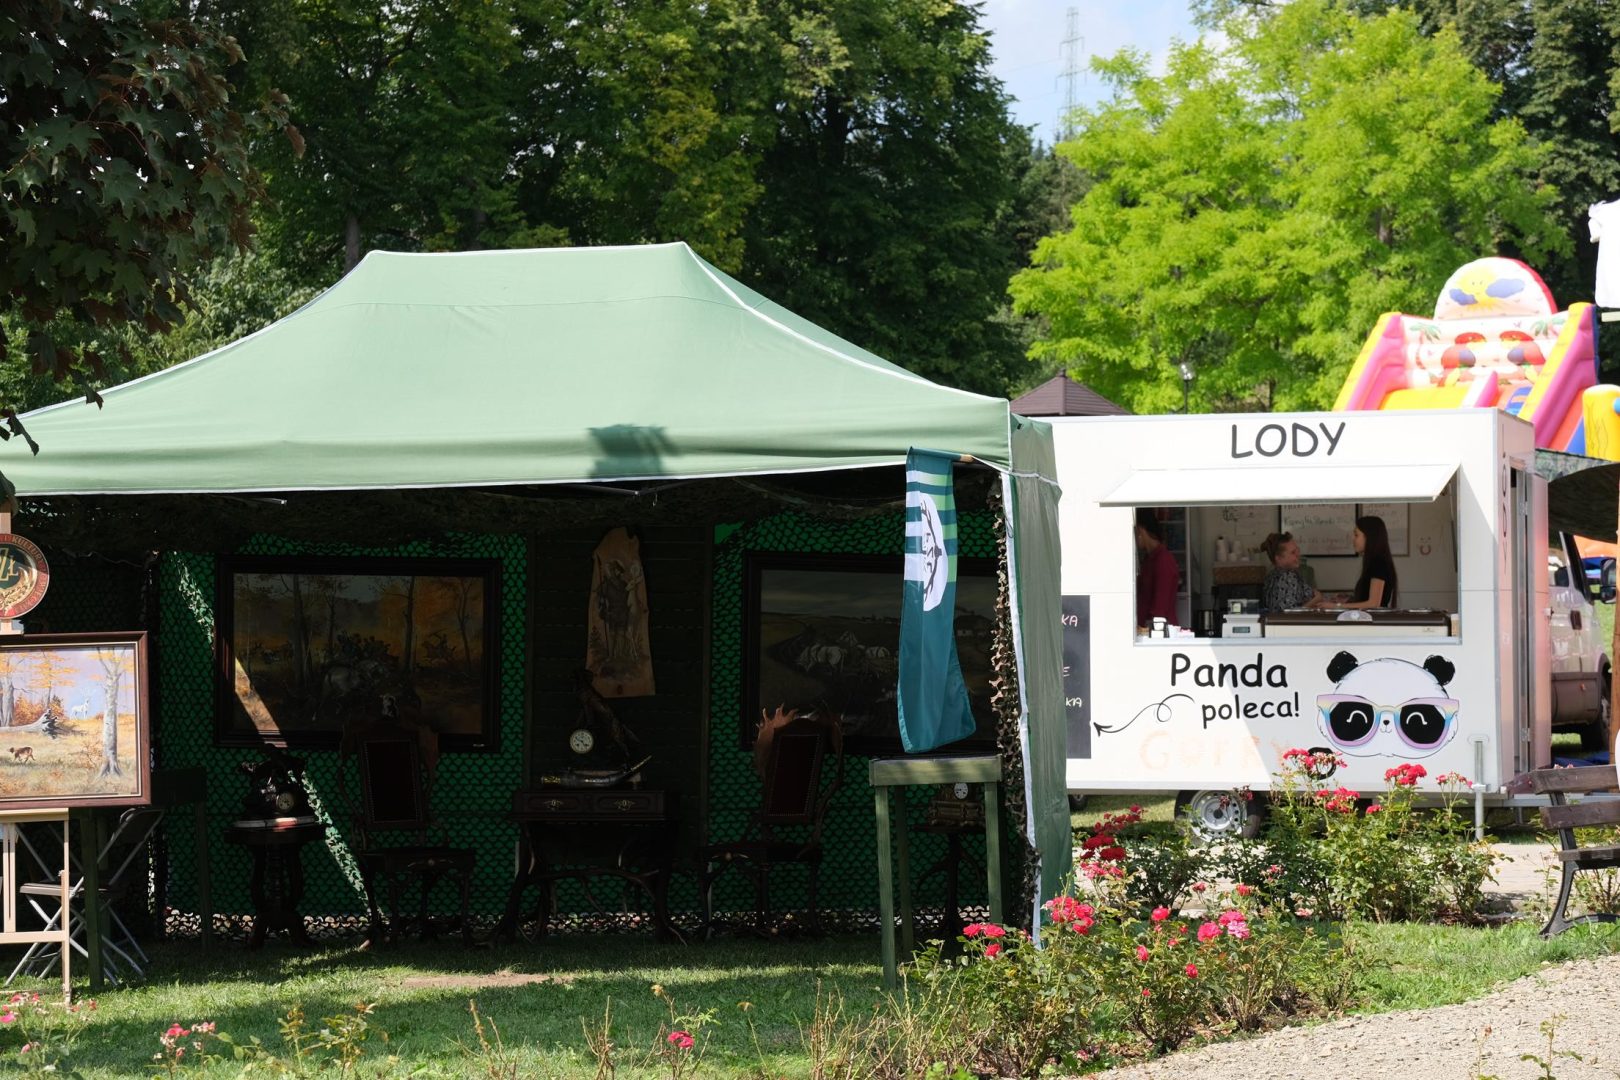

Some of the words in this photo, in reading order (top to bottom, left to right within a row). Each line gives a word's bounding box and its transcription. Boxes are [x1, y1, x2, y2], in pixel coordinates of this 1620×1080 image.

[1231, 422, 1346, 459] LODY
[1171, 652, 1288, 688] Panda
[1201, 691, 1300, 730] poleca!
